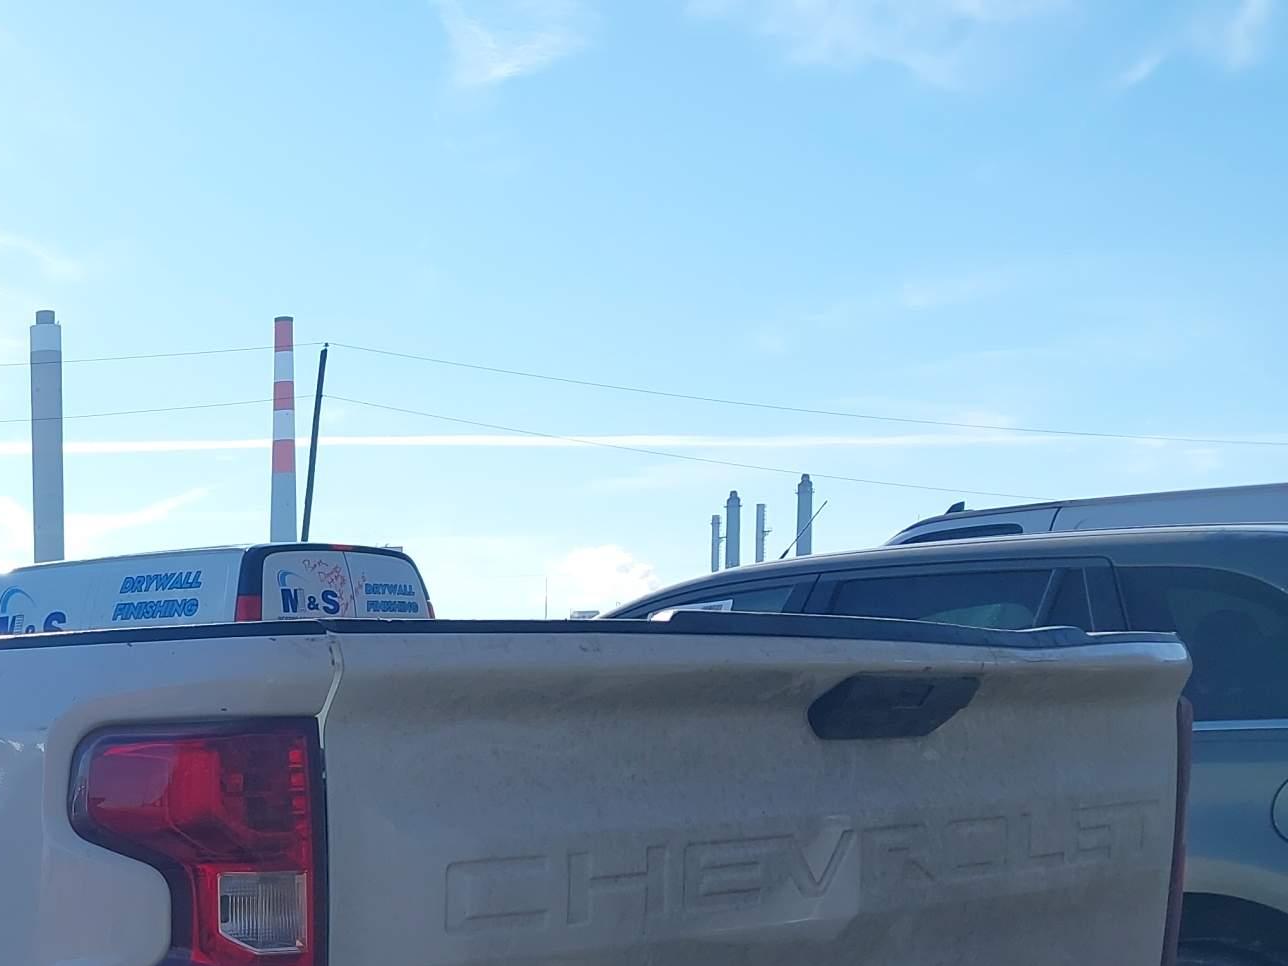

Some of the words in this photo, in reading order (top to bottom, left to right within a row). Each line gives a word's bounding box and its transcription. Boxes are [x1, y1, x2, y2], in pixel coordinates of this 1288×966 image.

[119, 570, 202, 594] DRYWALL
[364, 583, 415, 595] DRYWALL
[112, 598, 199, 621] FINISHING
[307, 595, 320, 611] &
[321, 589, 340, 615] S
[366, 600, 419, 614] FINISHING
[444, 799, 1160, 932] CHEVROLET
